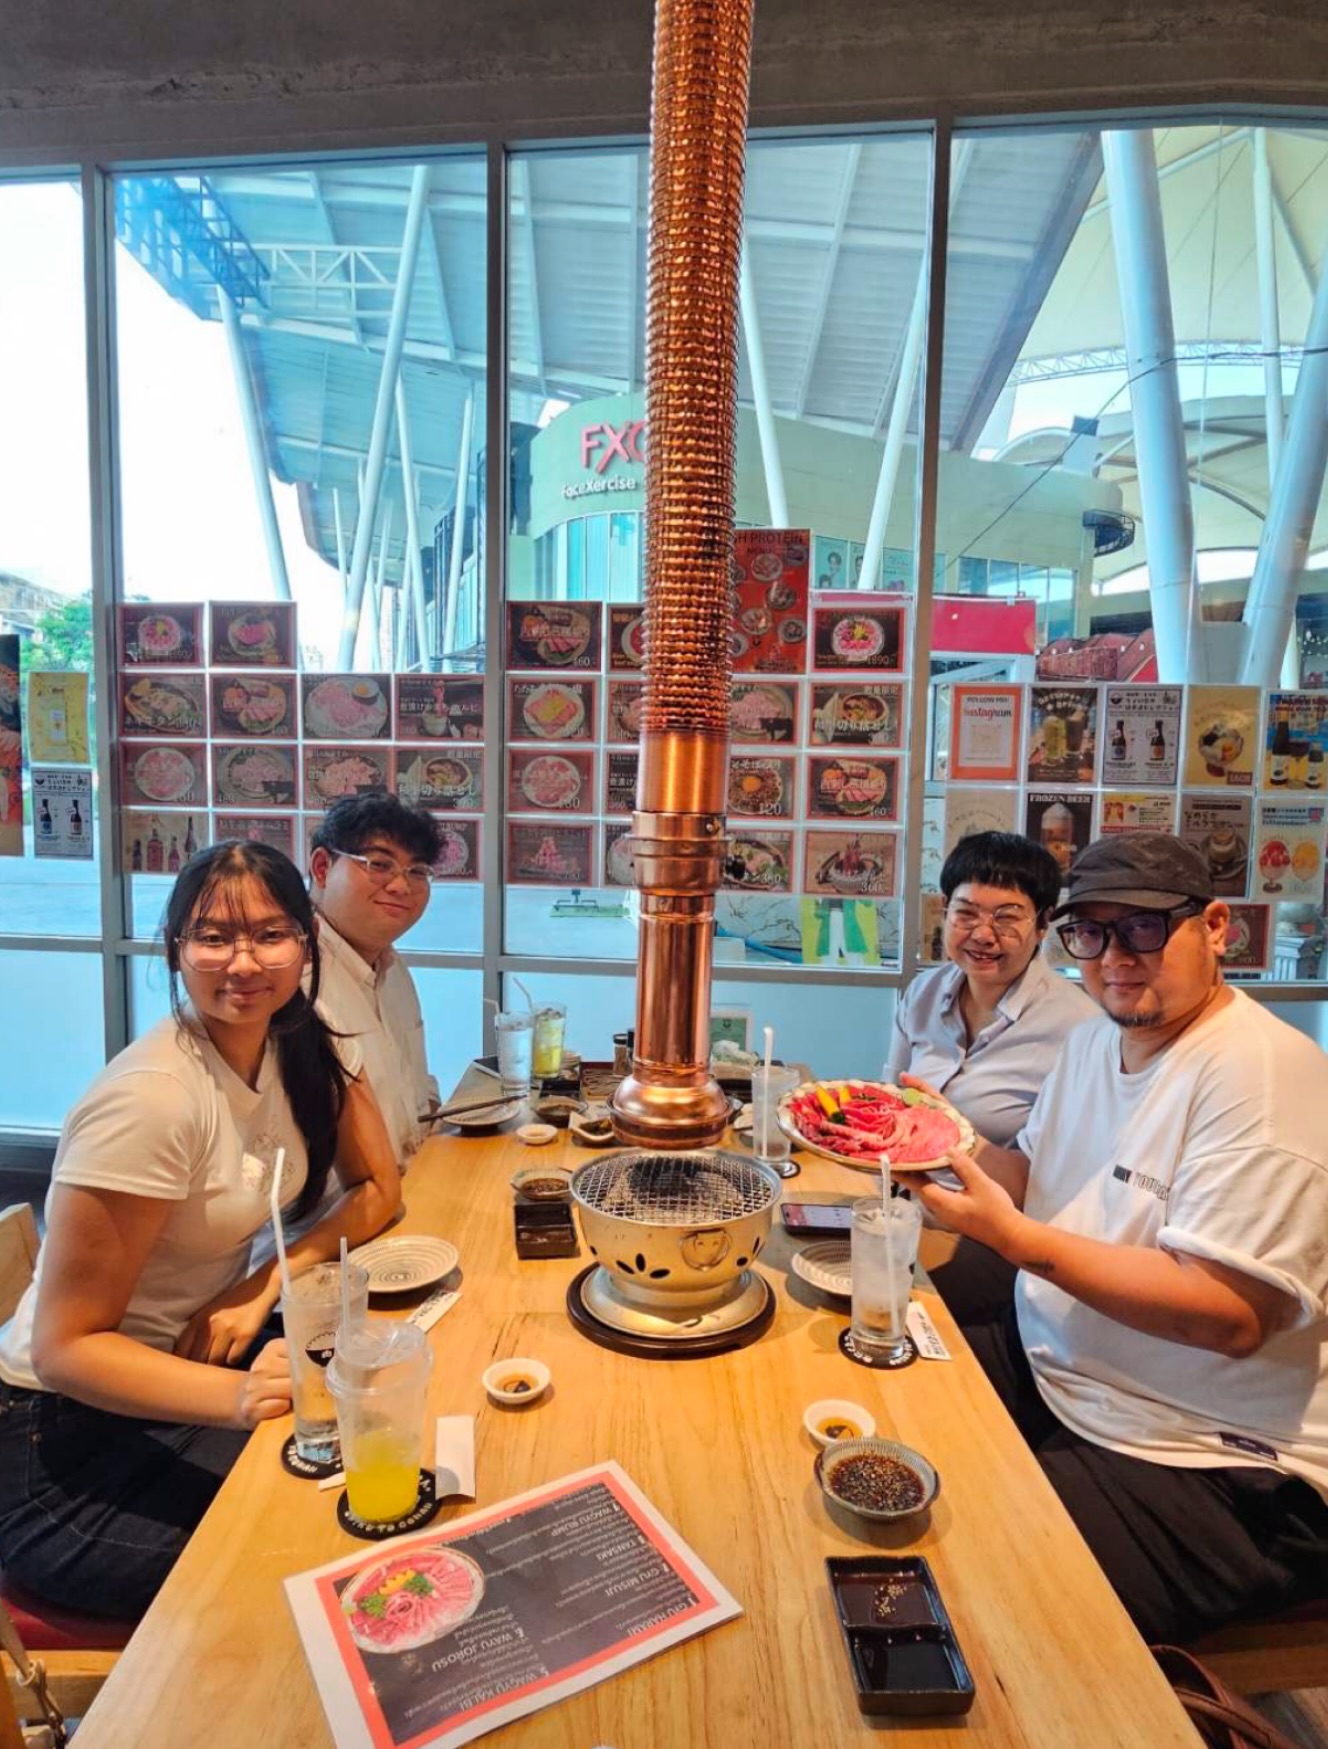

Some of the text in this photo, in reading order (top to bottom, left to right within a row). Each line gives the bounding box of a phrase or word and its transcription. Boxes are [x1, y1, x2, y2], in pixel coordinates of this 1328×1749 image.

[750, 531, 803, 543] PROTEIN
[639, 1567, 661, 1582] GYU
[604, 1576, 640, 1597] MISUJI
[666, 1602, 688, 1617] GYU
[626, 1610, 668, 1637] HARAMI
[480, 1632, 514, 1651] WAYU
[431, 1643, 479, 1673] JOROSU
[495, 1672, 538, 1695] WAGYU
